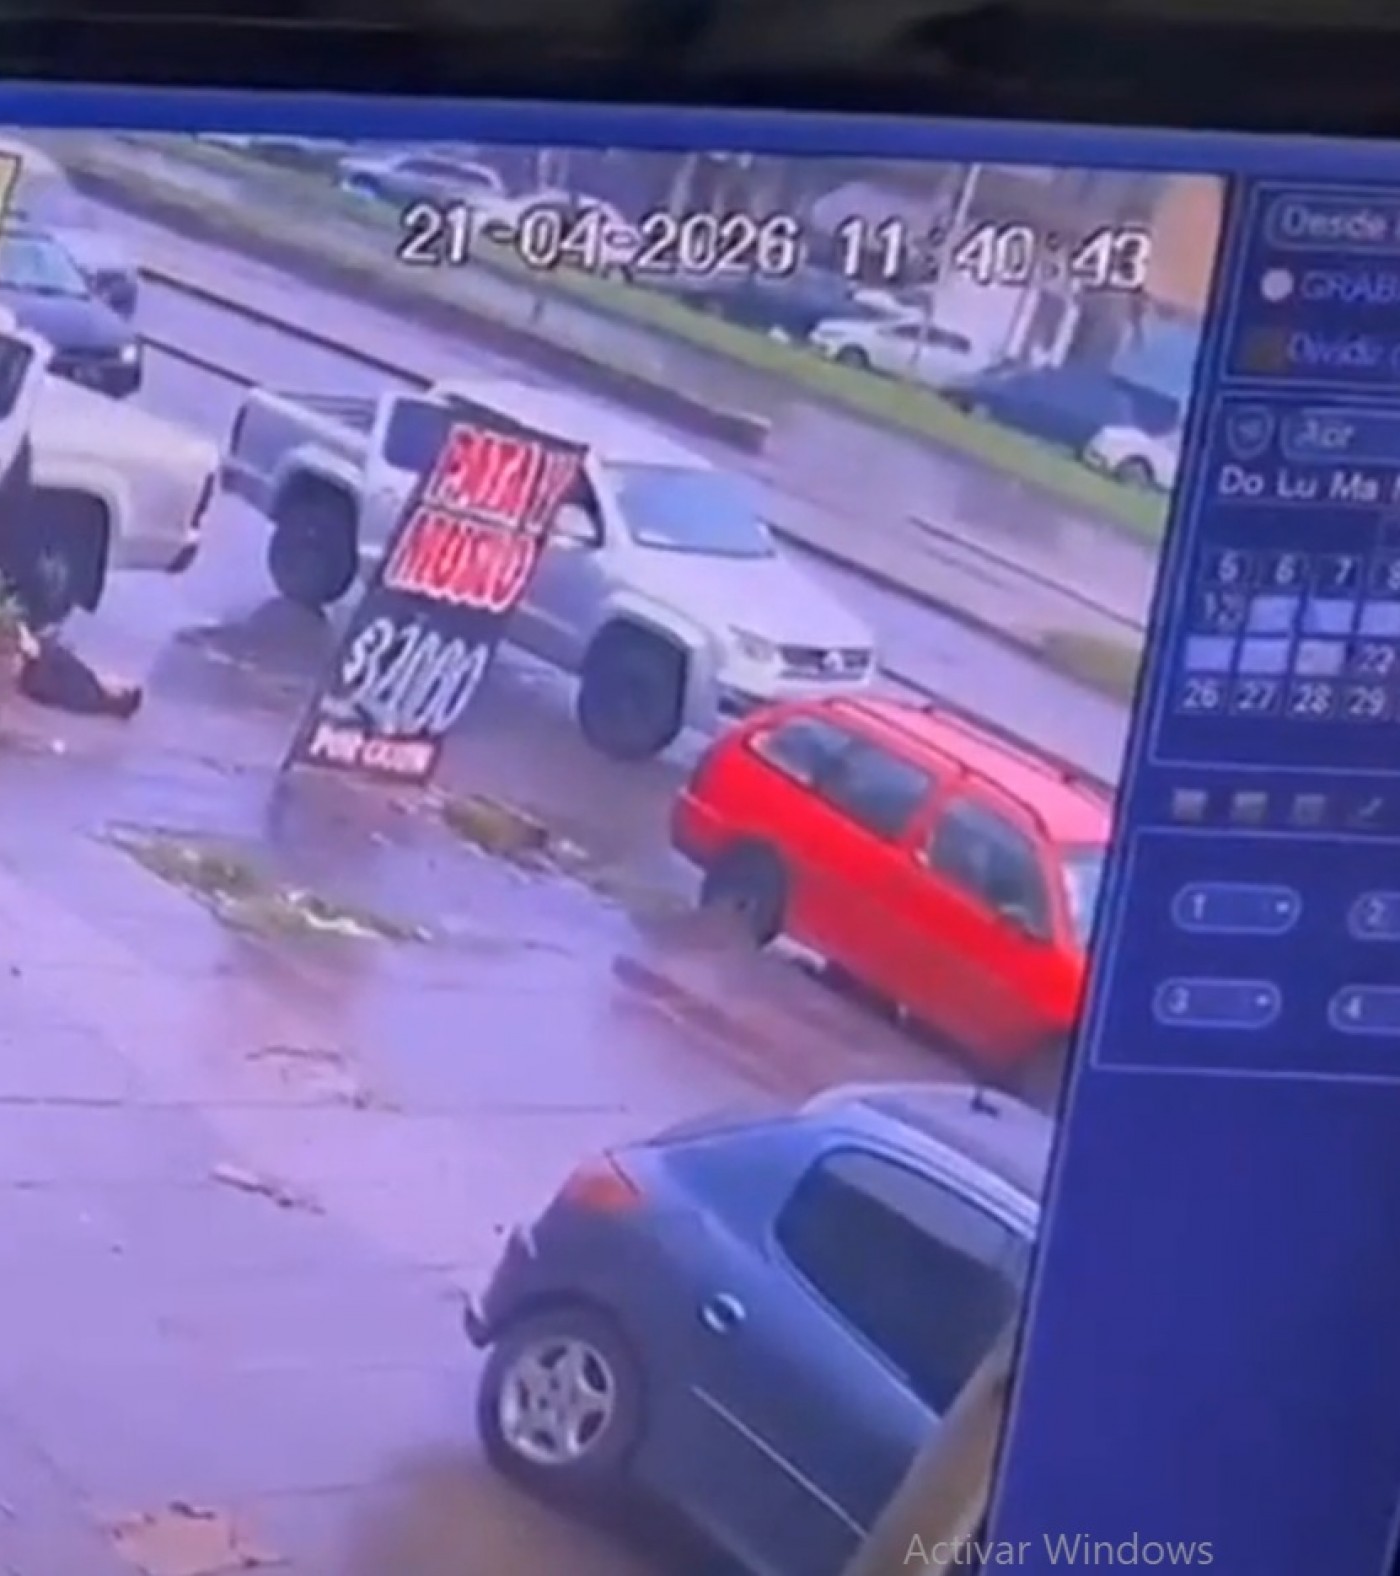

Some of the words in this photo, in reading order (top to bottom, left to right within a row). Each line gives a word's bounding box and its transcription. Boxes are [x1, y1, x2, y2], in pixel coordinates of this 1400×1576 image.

[1220, 464, 1265, 495] Do
[1277, 467, 1318, 498] Lu
[1330, 470, 1380, 501] Ma
[1217, 550, 1240, 583] 5
[1275, 554, 1297, 584] 6
[1335, 556, 1352, 585] 7
[1184, 682, 1219, 709] 26
[1239, 682, 1277, 711] 27
[1294, 684, 1333, 714] 28
[1349, 686, 1385, 716] 29
[1192, 893, 1207, 921] 1
[1366, 897, 1387, 926] 2
[1167, 985, 1190, 1015] 3
[1344, 995, 1363, 1020] 4
